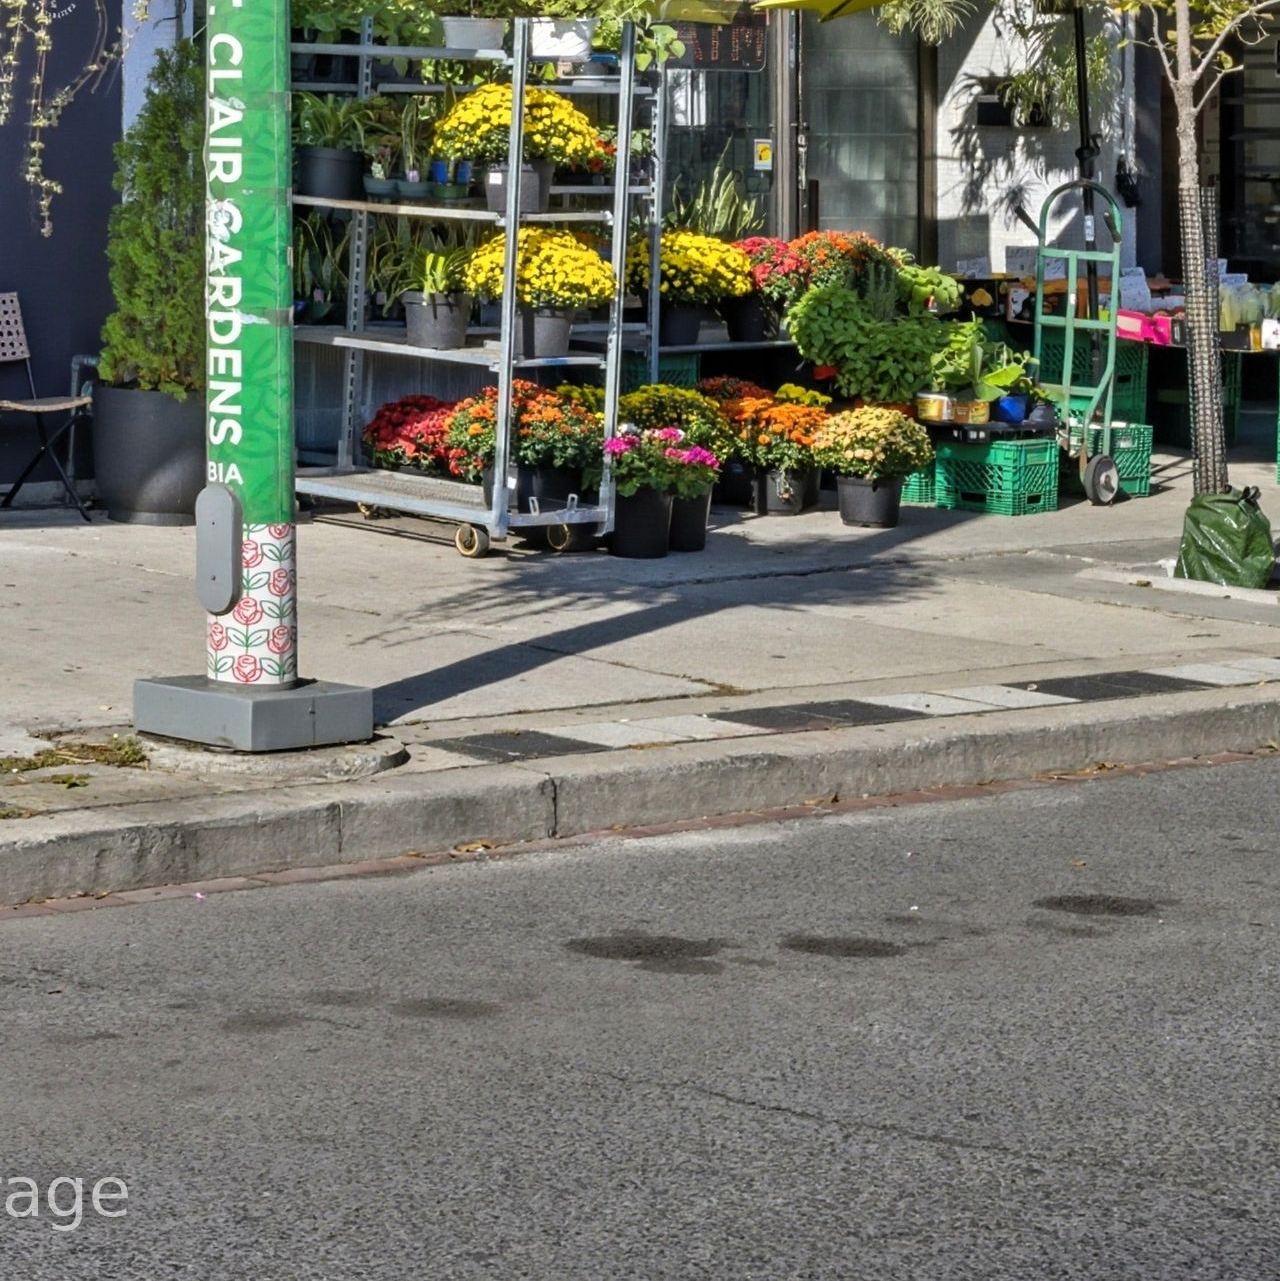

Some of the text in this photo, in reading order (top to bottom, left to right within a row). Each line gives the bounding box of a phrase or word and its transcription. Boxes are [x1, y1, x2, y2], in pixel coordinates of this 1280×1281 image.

[209, 33, 245, 184] CLAIR
[208, 199, 243, 447] GARDENS
[208, 460, 244, 485] BIA
